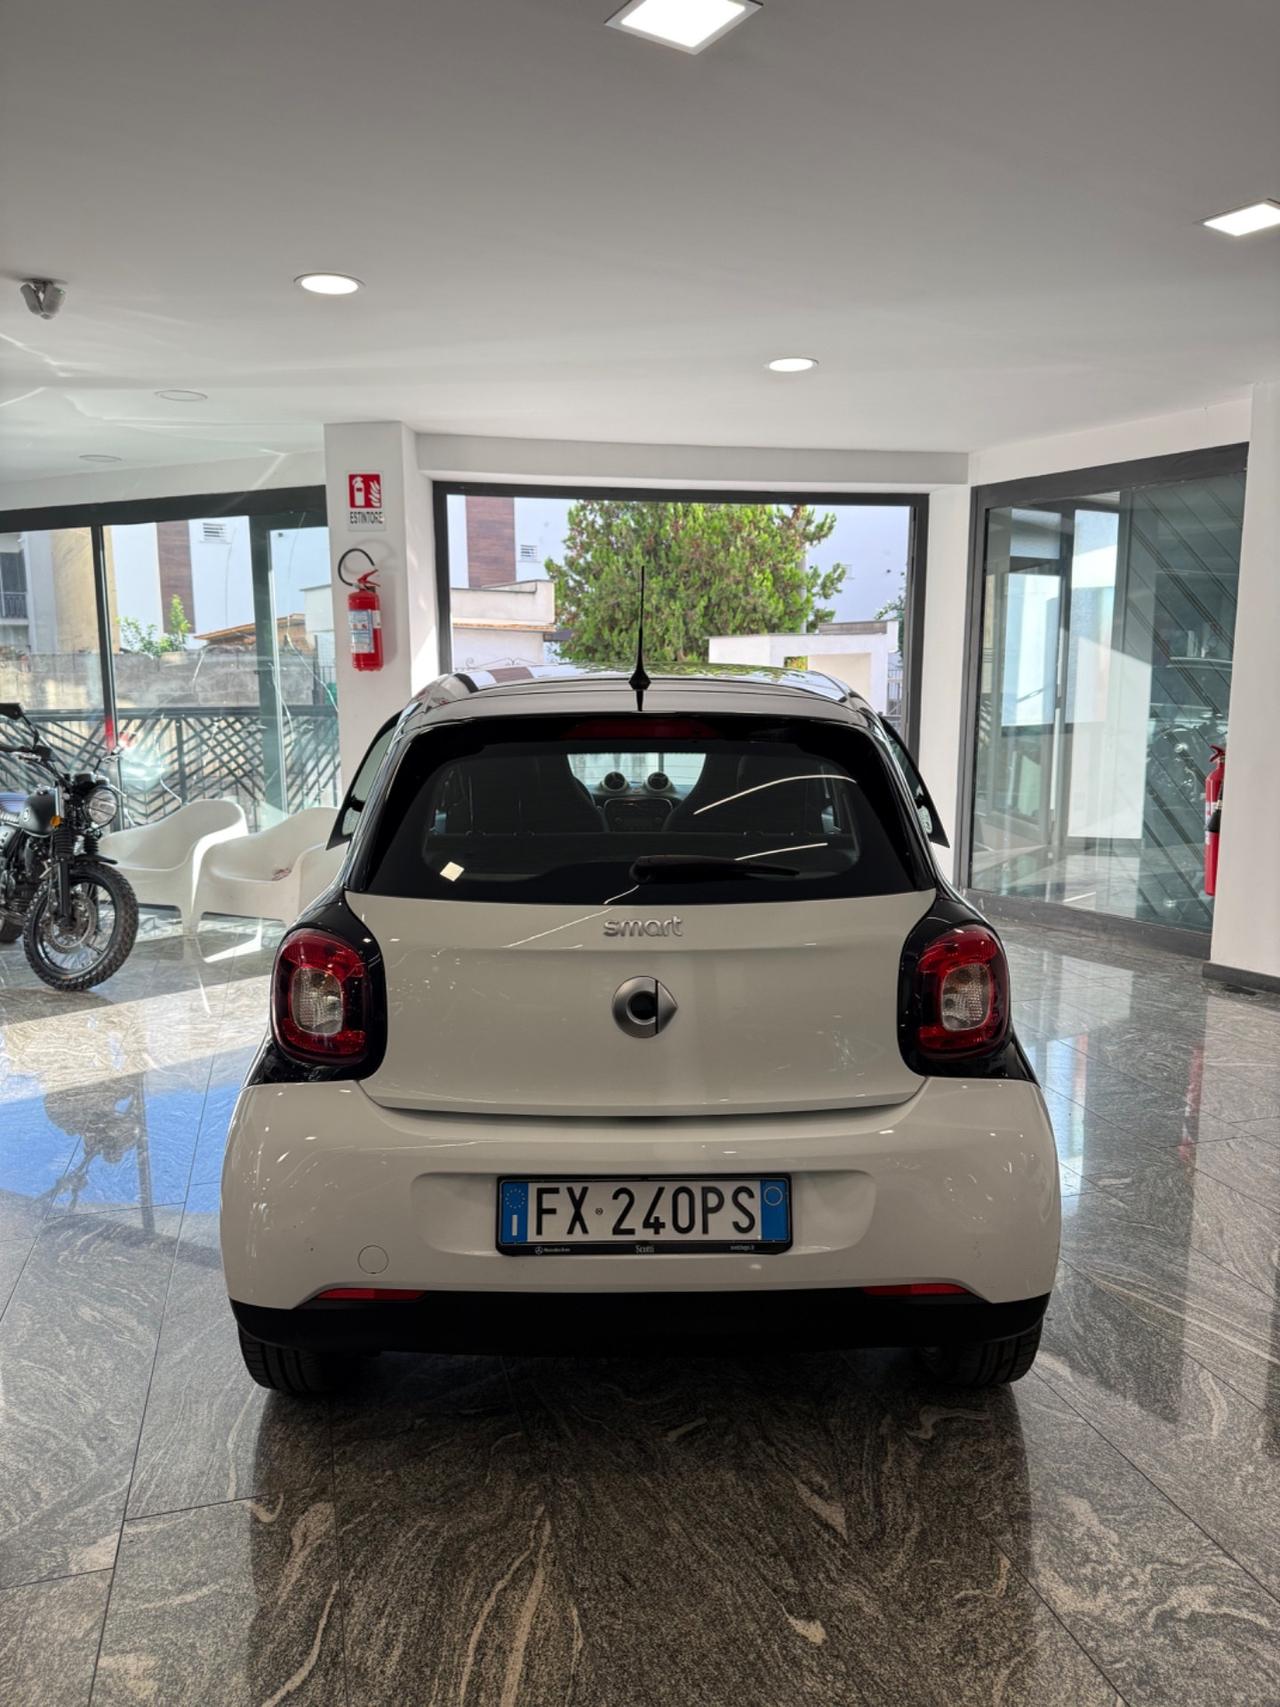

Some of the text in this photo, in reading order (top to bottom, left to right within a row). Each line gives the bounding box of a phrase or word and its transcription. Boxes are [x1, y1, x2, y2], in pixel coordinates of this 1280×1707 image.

[350, 511, 383, 524] ESTINTORE
[603, 916, 683, 937] smart
[535, 1185, 757, 1236] FX 240PS
